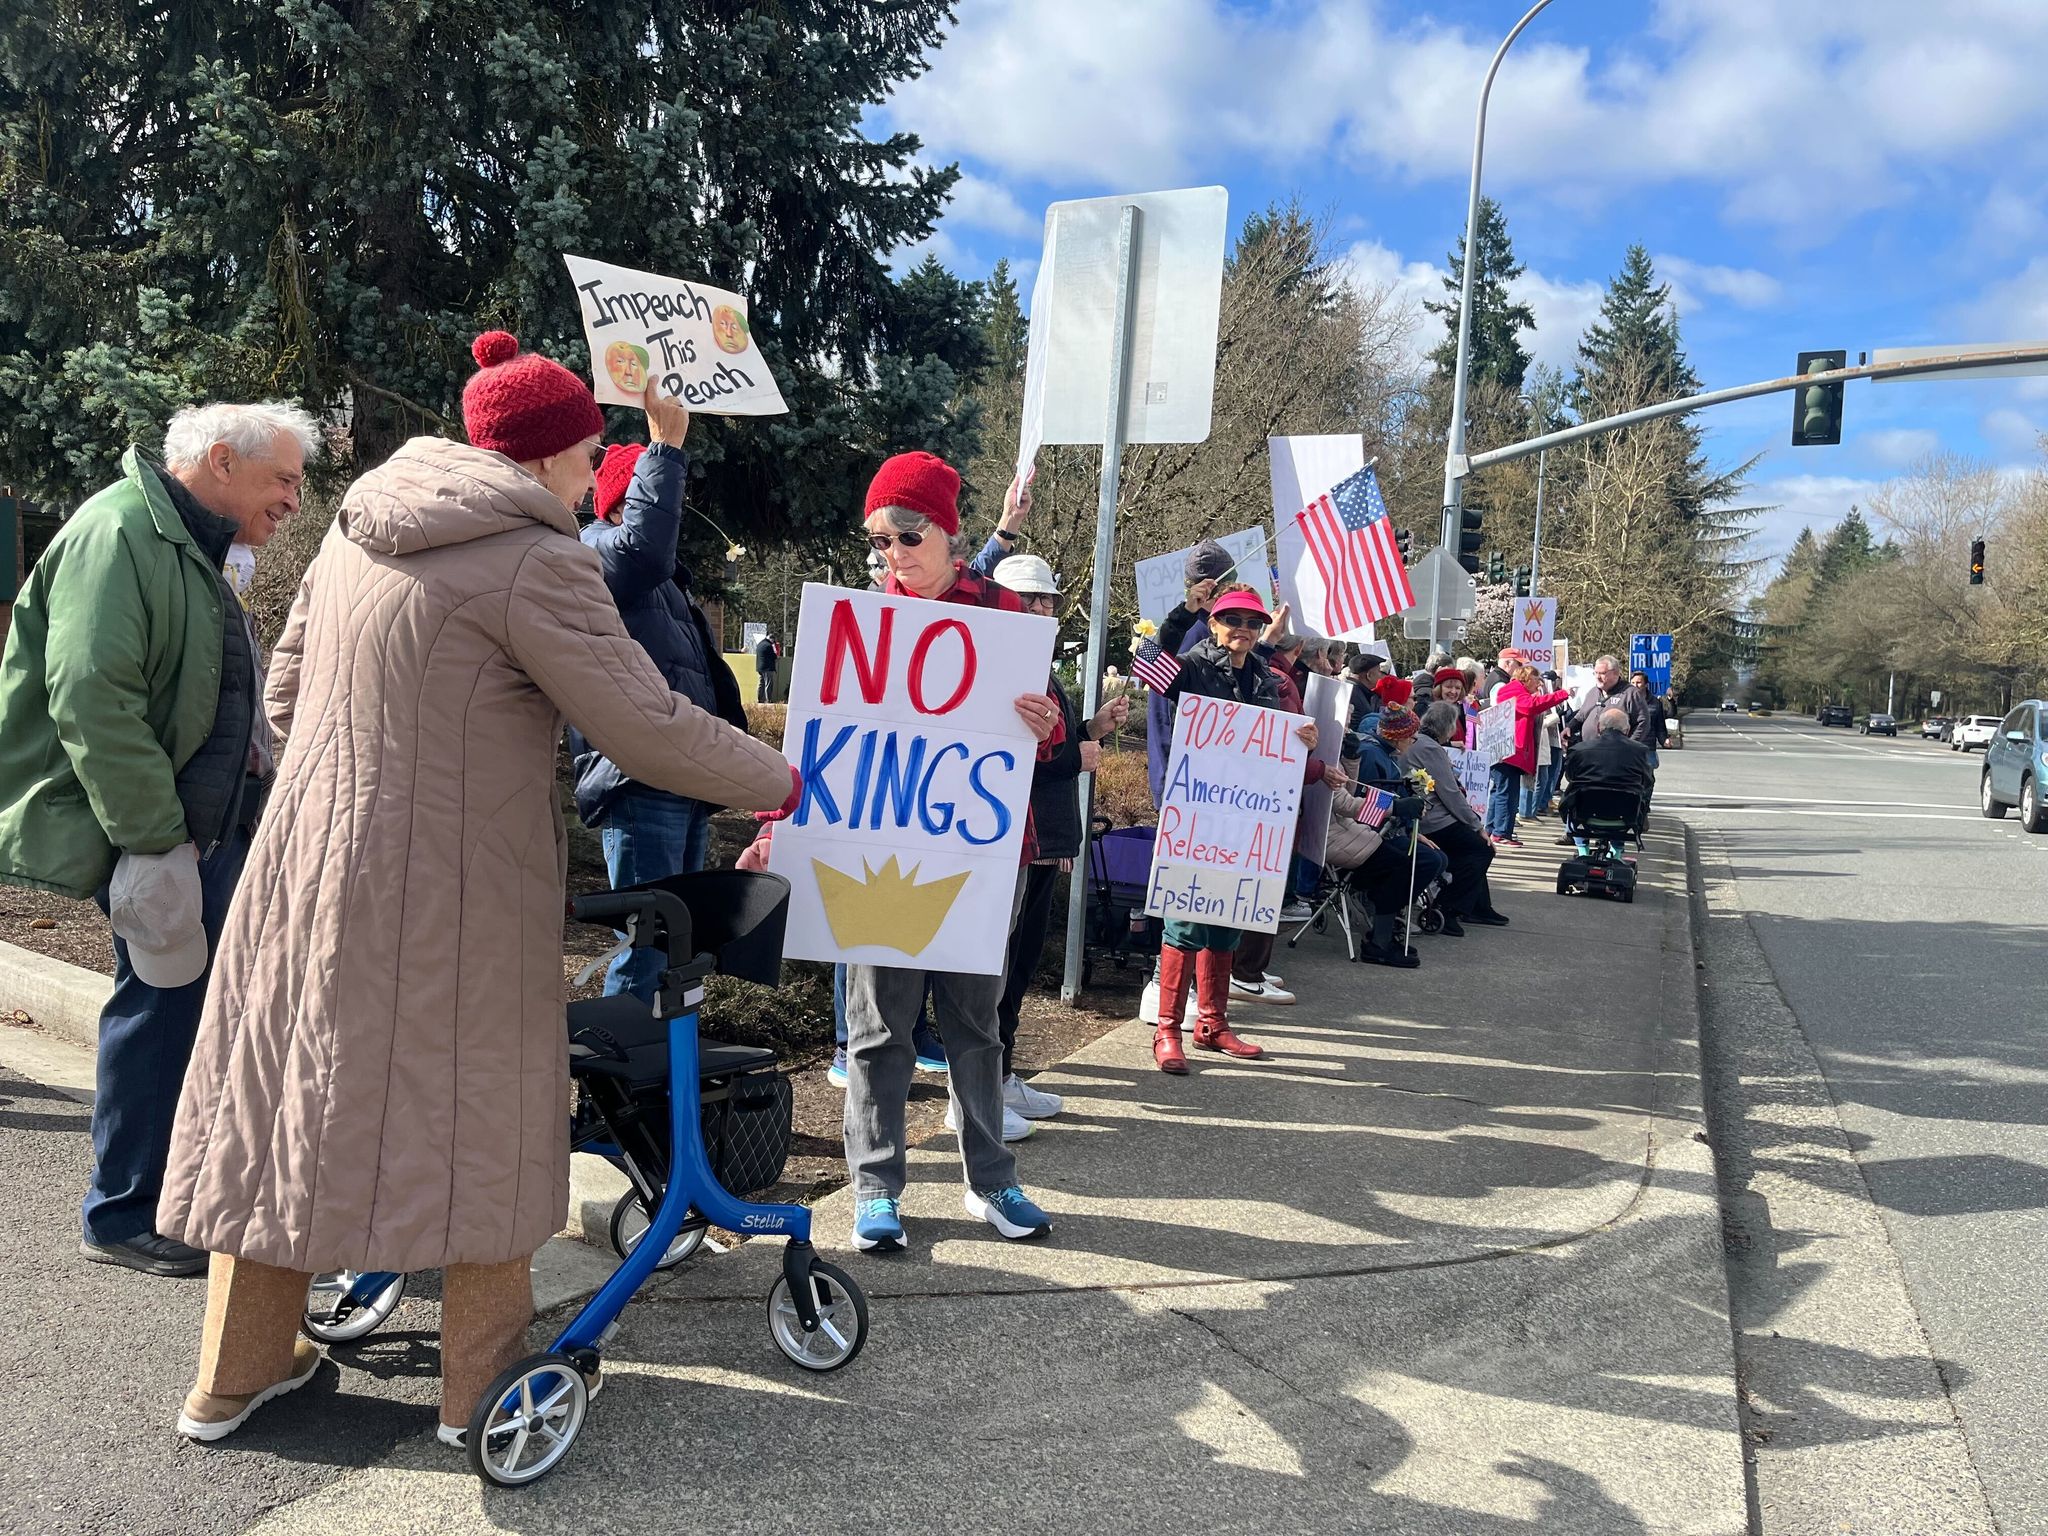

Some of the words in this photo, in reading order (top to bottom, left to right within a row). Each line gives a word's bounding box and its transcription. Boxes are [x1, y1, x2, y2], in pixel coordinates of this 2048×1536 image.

[578, 279, 713, 328] Impeach
[646, 328, 697, 370] This
[661, 361, 755, 407] Peach
[819, 599, 978, 716] NO
[1518, 649, 1552, 662] INGS
[1523, 630, 1543, 643] NO
[1632, 652, 1671, 669] TRUMP
[1181, 695, 1241, 750] 90%
[1242, 710, 1295, 763] ALL
[791, 718, 1015, 845] KINGS
[1466, 751, 1486, 772] Rides
[1156, 805, 1239, 865] Release
[1245, 822, 1287, 873] ALL
[1149, 866, 1225, 917] Epstein
[1232, 878, 1275, 924] Files
[740, 1213, 785, 1228] Stella
